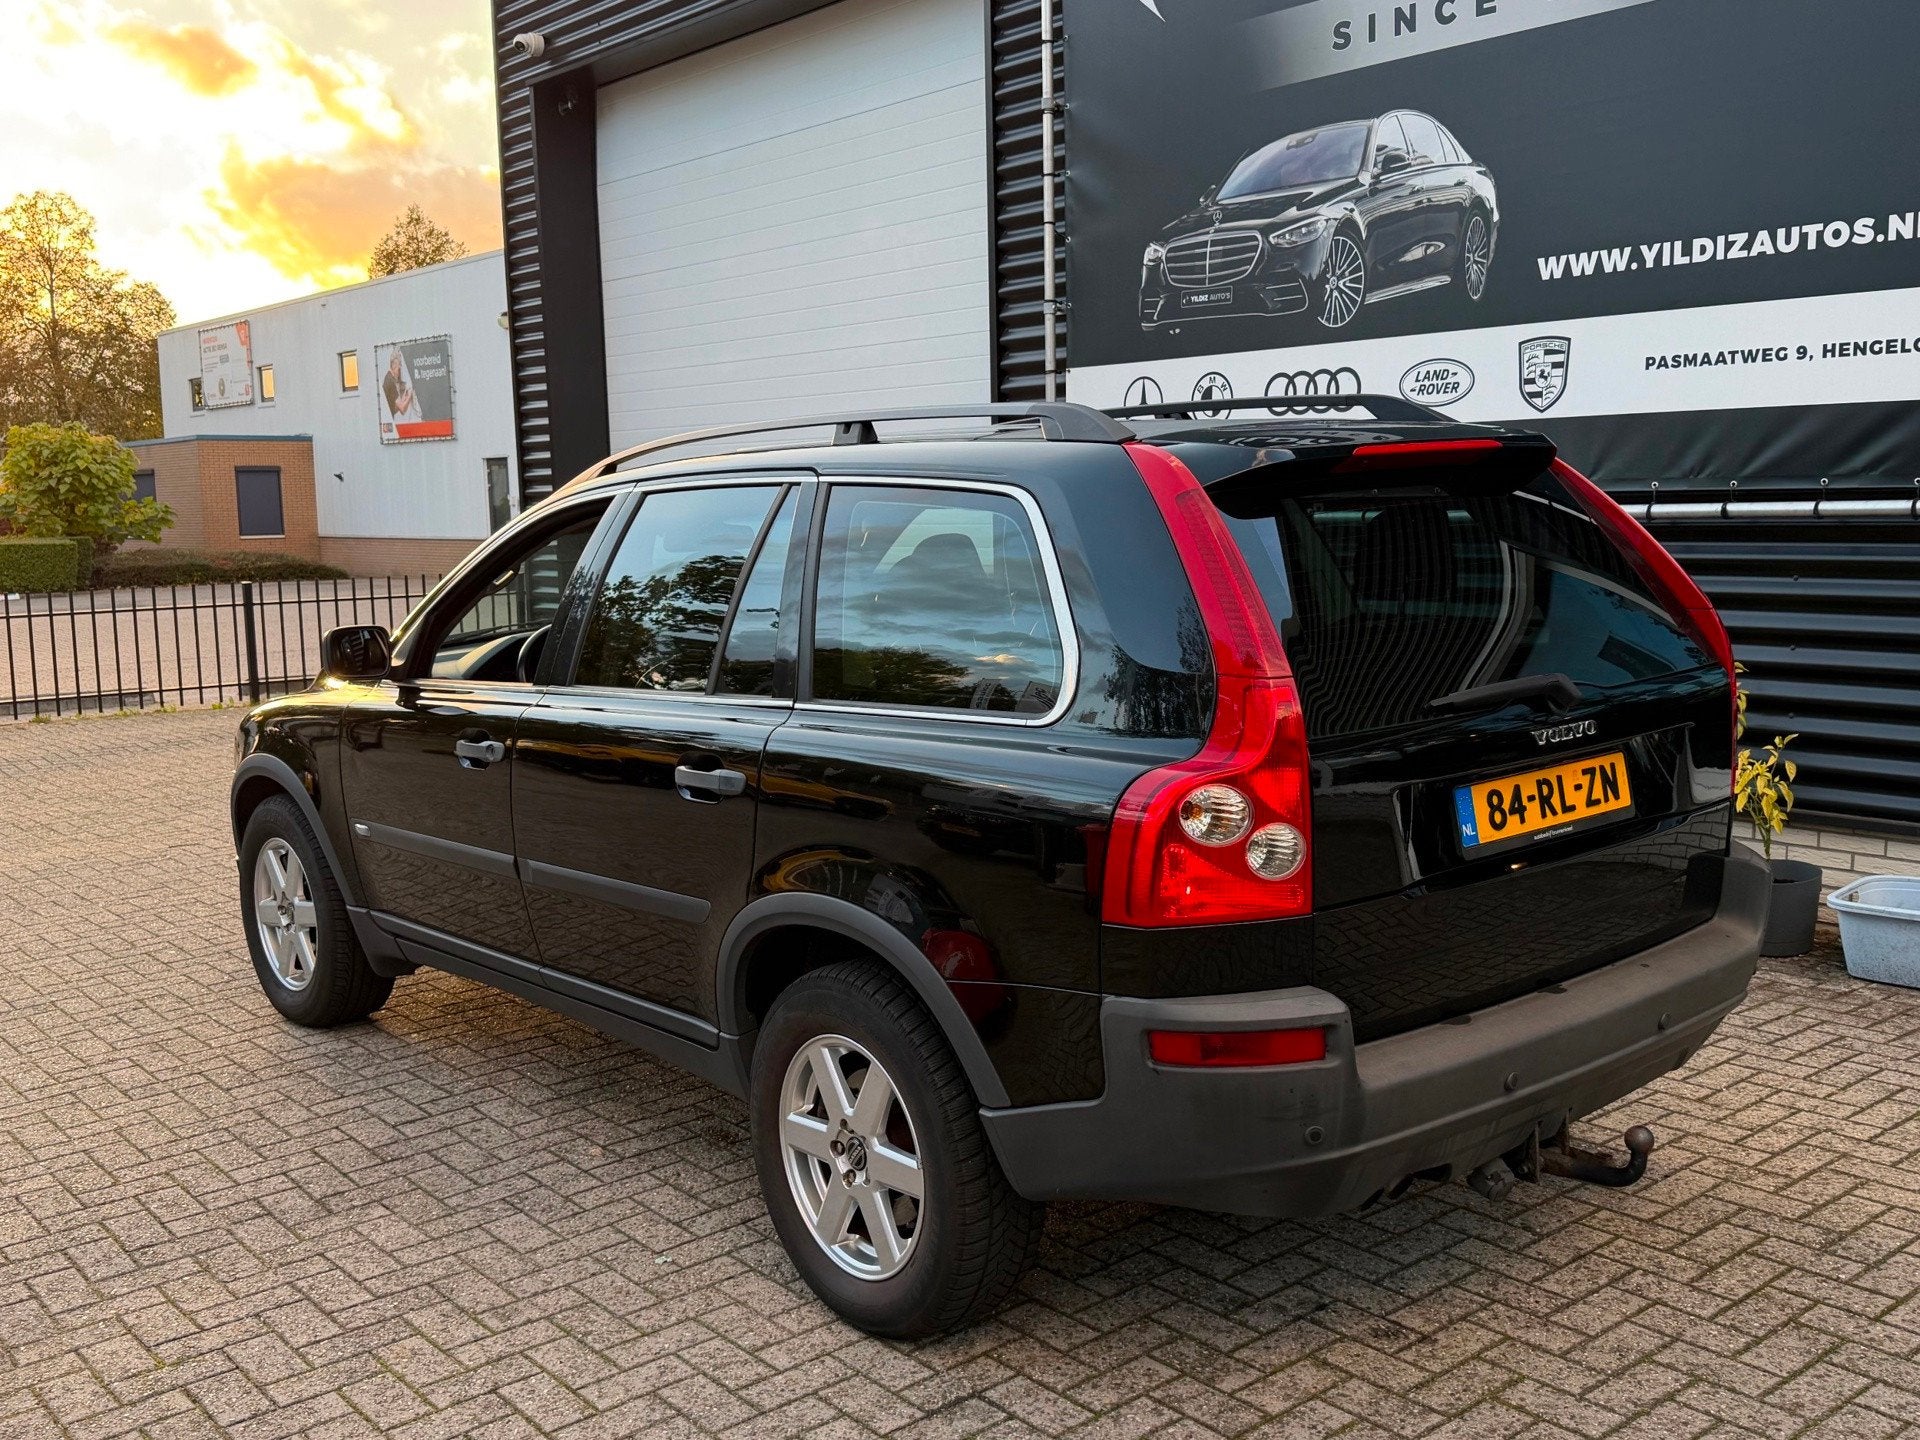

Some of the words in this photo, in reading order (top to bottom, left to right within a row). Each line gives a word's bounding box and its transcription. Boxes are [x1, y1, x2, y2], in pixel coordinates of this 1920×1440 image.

[1537, 211, 1920, 281] WWW.YILDIZAUTOS.N
[1190, 294, 1209, 303] YILDIZ
[1523, 342, 1565, 352] PORSCHE
[1644, 346, 1789, 370] PASMAATWEG
[1796, 345, 1814, 362] 9,
[1531, 719, 1598, 745] VOLVO
[1485, 762, 1621, 832] 84-RL-ZN
[1461, 824, 1476, 837] NL
